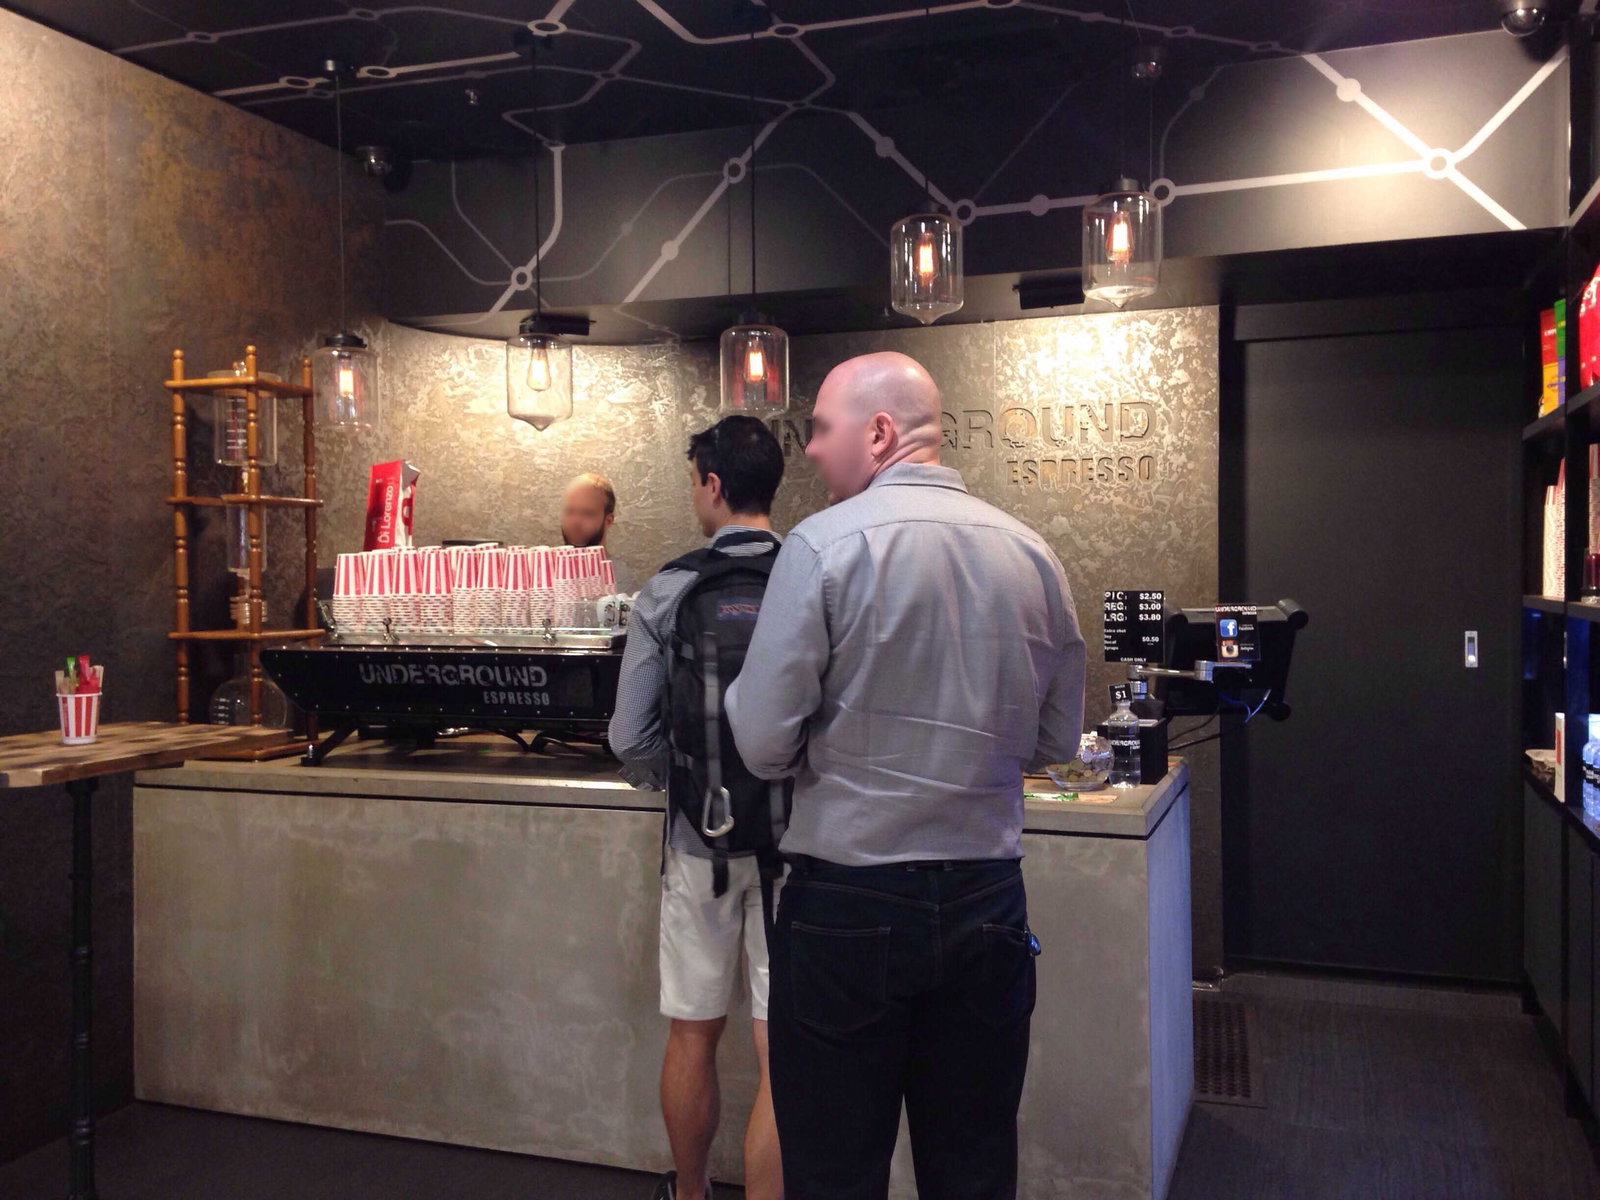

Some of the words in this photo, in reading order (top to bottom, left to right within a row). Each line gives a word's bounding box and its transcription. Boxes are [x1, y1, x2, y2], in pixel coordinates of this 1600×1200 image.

[1006, 454, 1156, 487] ESPRESSO
[380, 485, 395, 529] Lorenzo
[1139, 592, 1162, 601] $2.50
[1138, 602, 1162, 611] $3.00
[1138, 613, 1162, 622] $3.80
[358, 663, 549, 688] UNDERGROUND
[483, 690, 550, 707] ESPRESSO
[1115, 690, 1127, 700] $1
